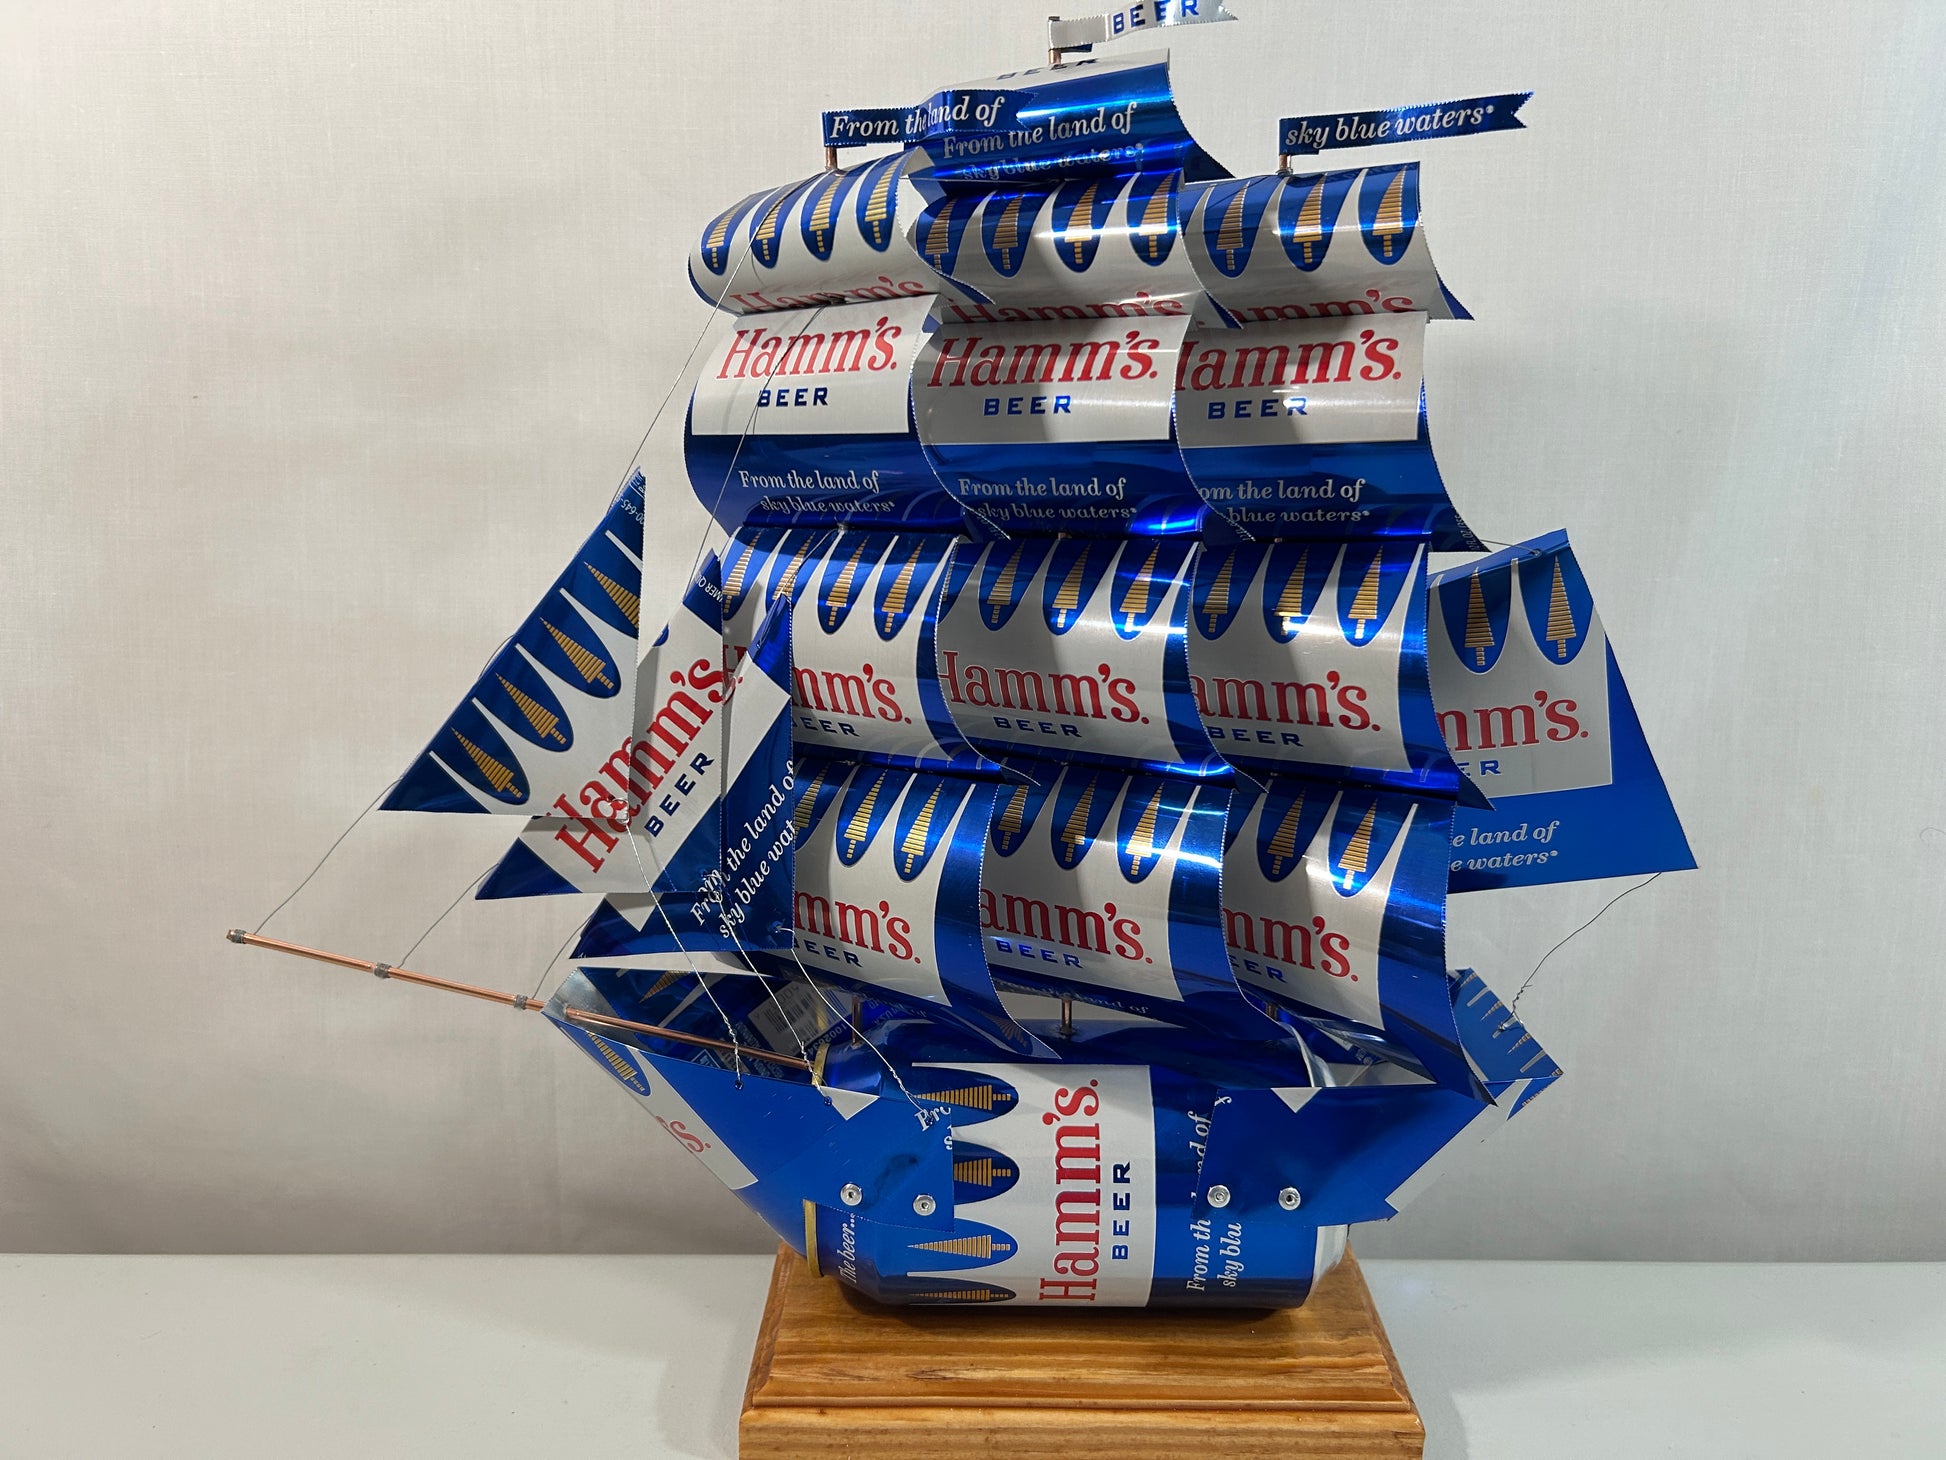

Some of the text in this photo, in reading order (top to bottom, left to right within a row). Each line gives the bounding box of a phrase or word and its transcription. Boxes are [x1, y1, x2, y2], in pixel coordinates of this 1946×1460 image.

[1112, 0, 1199, 35] BEER
[830, 96, 1006, 139] From the land of
[943, 134, 1004, 159] From
[1048, 106, 1106, 142] land
[1110, 101, 1137, 135] of
[1285, 120, 1330, 149] sky
[1334, 115, 1390, 141] blue
[716, 316, 902, 380] Hamm's.
[927, 331, 1160, 388] Hamm's.
[757, 386, 829, 408] BEER
[983, 395, 1072, 417] BEER
[1207, 396, 1308, 420] BEER
[738, 469, 879, 494] From the land of
[958, 477, 1127, 501] From the land of
[1236, 481, 1273, 500] the
[1277, 479, 1336, 500] land
[1340, 478, 1367, 503] of
[760, 496, 791, 515] sky
[786, 496, 828, 513] blue
[978, 502, 1011, 521] sky
[1010, 502, 1056, 519] blue
[1226, 506, 1277, 523] blue
[993, 716, 1083, 738] BEER
[1206, 725, 1304, 748] BEER
[643, 751, 716, 838] BEER
[726, 837, 752, 872] the
[743, 784, 786, 840] land
[1469, 823, 1528, 846] land
[1532, 820, 1560, 844] of
[719, 901, 746, 939] sky
[734, 859, 771, 905] blue
[981, 888, 1153, 964] amm's.
[995, 939, 1084, 969] BEER
[1038, 1078, 1100, 1301] Hamm's.
[1111, 1160, 1131, 1260] BEER
[1186, 1243, 1211, 1292] From
[1216, 1221, 1245, 1288] sky blu
[838, 1259, 857, 1284] The
